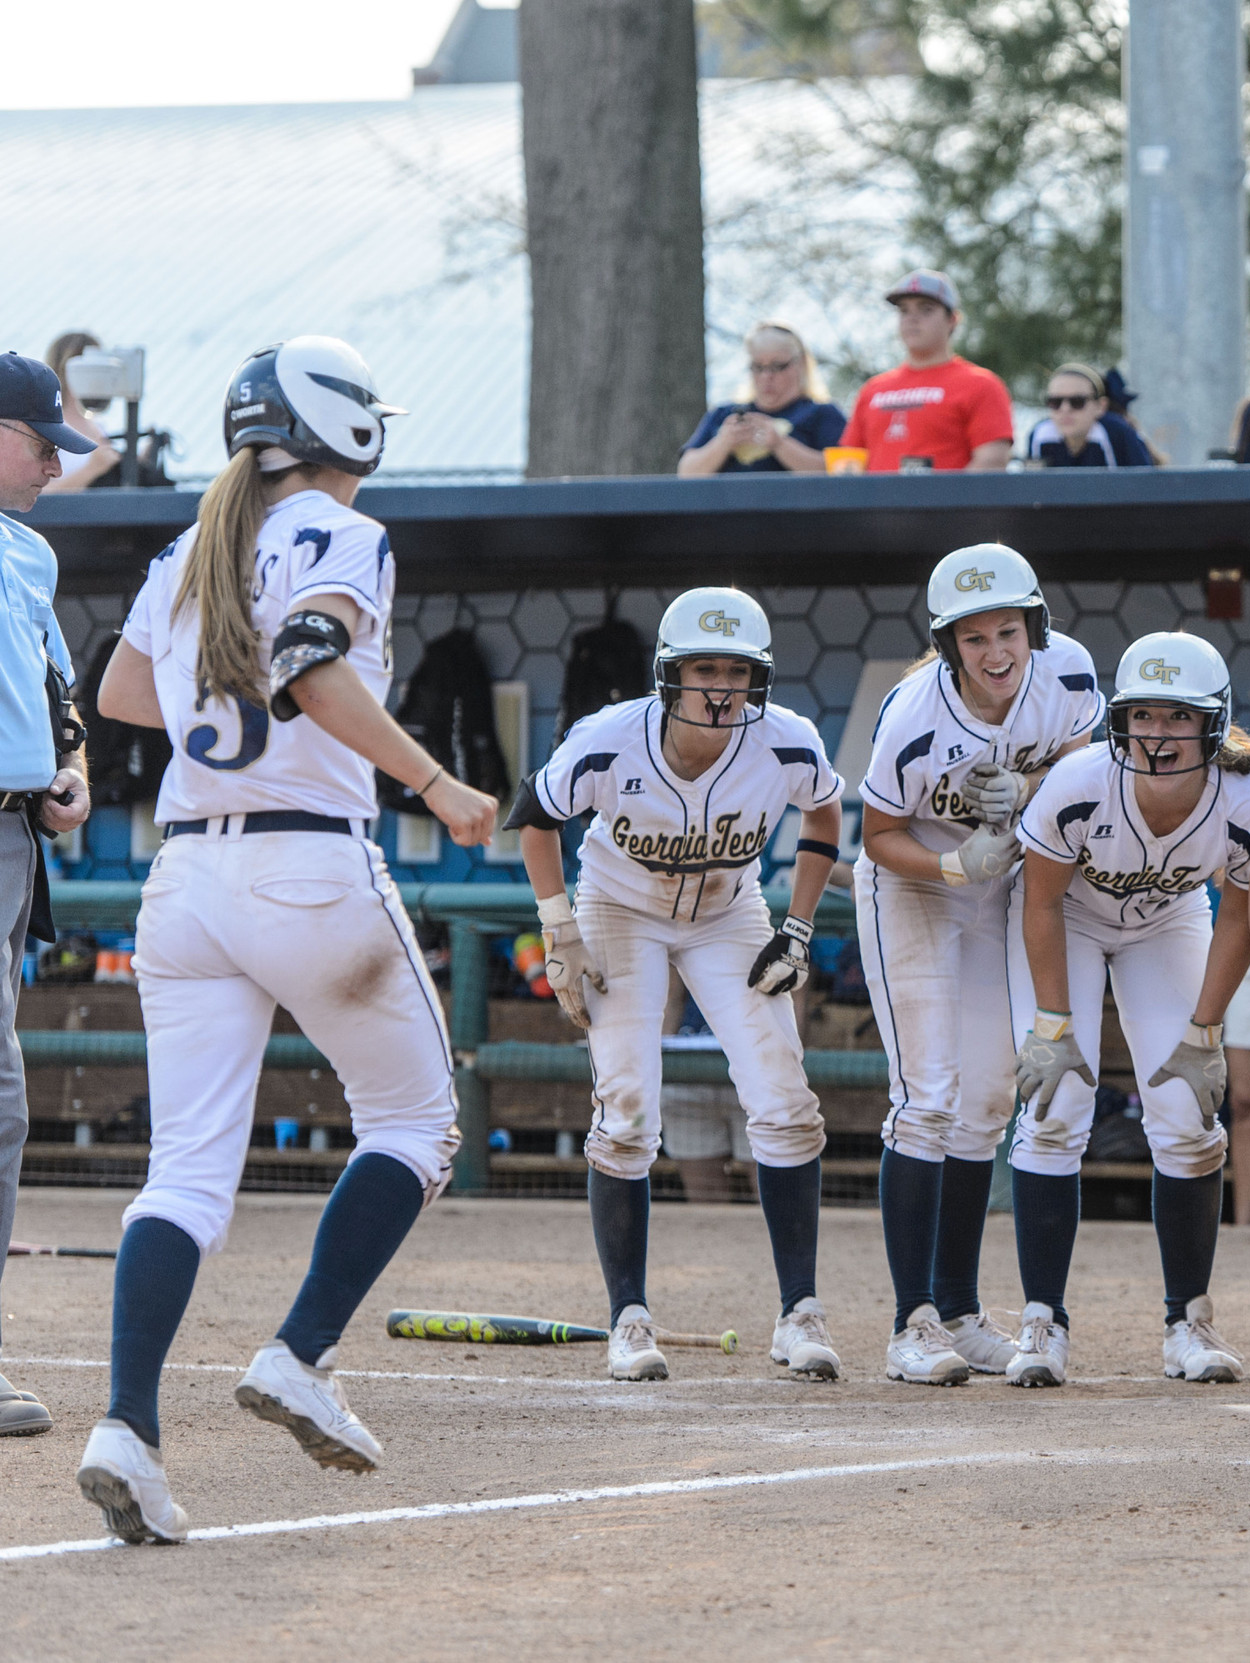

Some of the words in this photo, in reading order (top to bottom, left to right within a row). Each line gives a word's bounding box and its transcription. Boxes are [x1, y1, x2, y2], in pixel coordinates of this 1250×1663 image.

[240, 381, 252, 403] 5
[954, 567, 996, 592] GT
[698, 609, 741, 637] GT
[1138, 657, 1181, 685] GT
[612, 815, 709, 878] Georgia
[711, 809, 768, 859] Tech
[1076, 844, 1164, 900] Georgia
[1160, 864, 1206, 892] Tec
